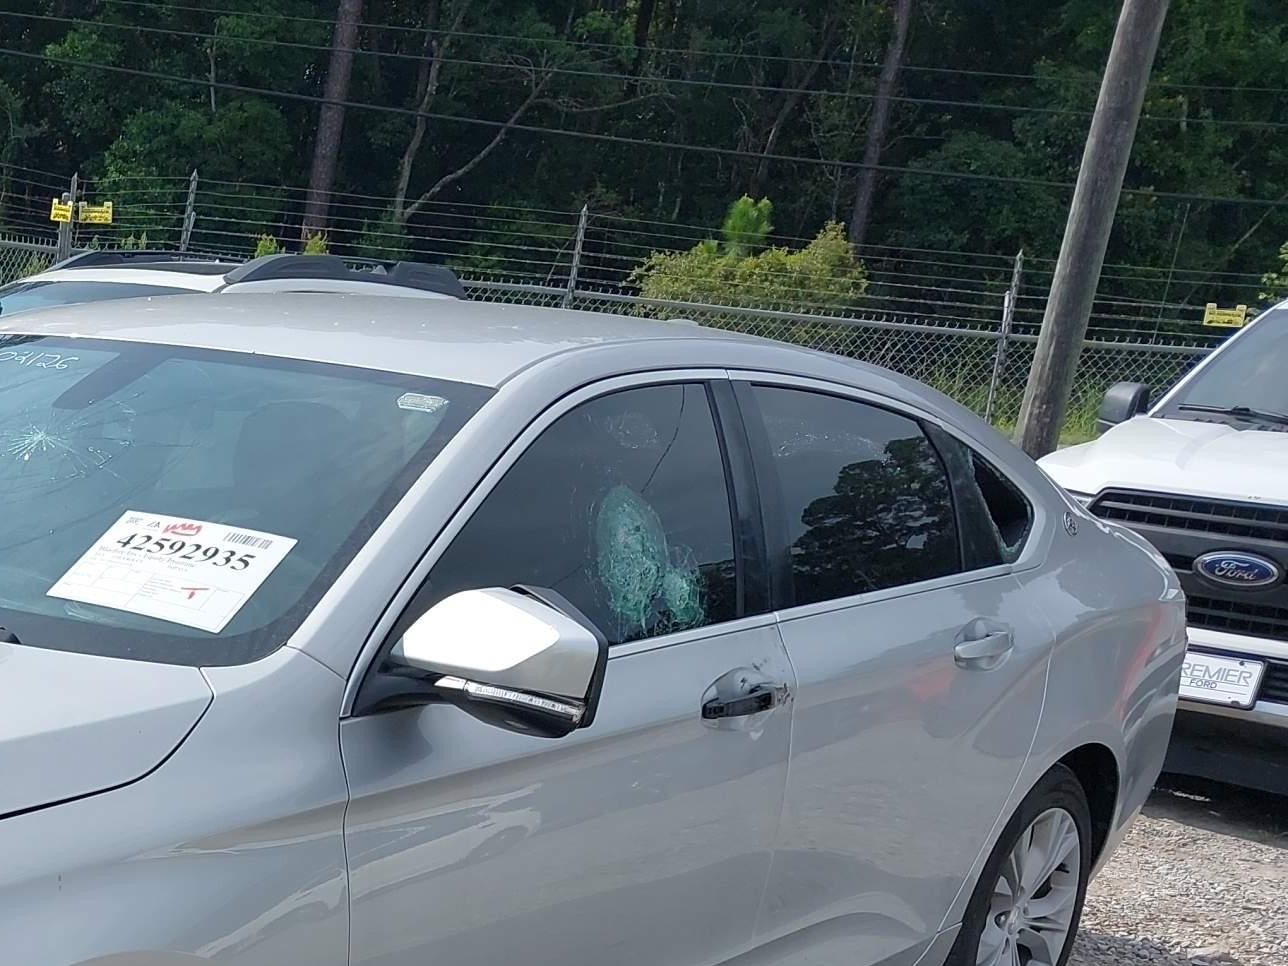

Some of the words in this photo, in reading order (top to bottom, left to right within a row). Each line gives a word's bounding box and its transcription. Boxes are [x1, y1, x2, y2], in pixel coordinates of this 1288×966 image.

[116, 532, 257, 571] 42592935
[1214, 559, 1258, 581] Ford
[1181, 662, 1253, 686] REMIER
[1190, 678, 1218, 689] FORD
